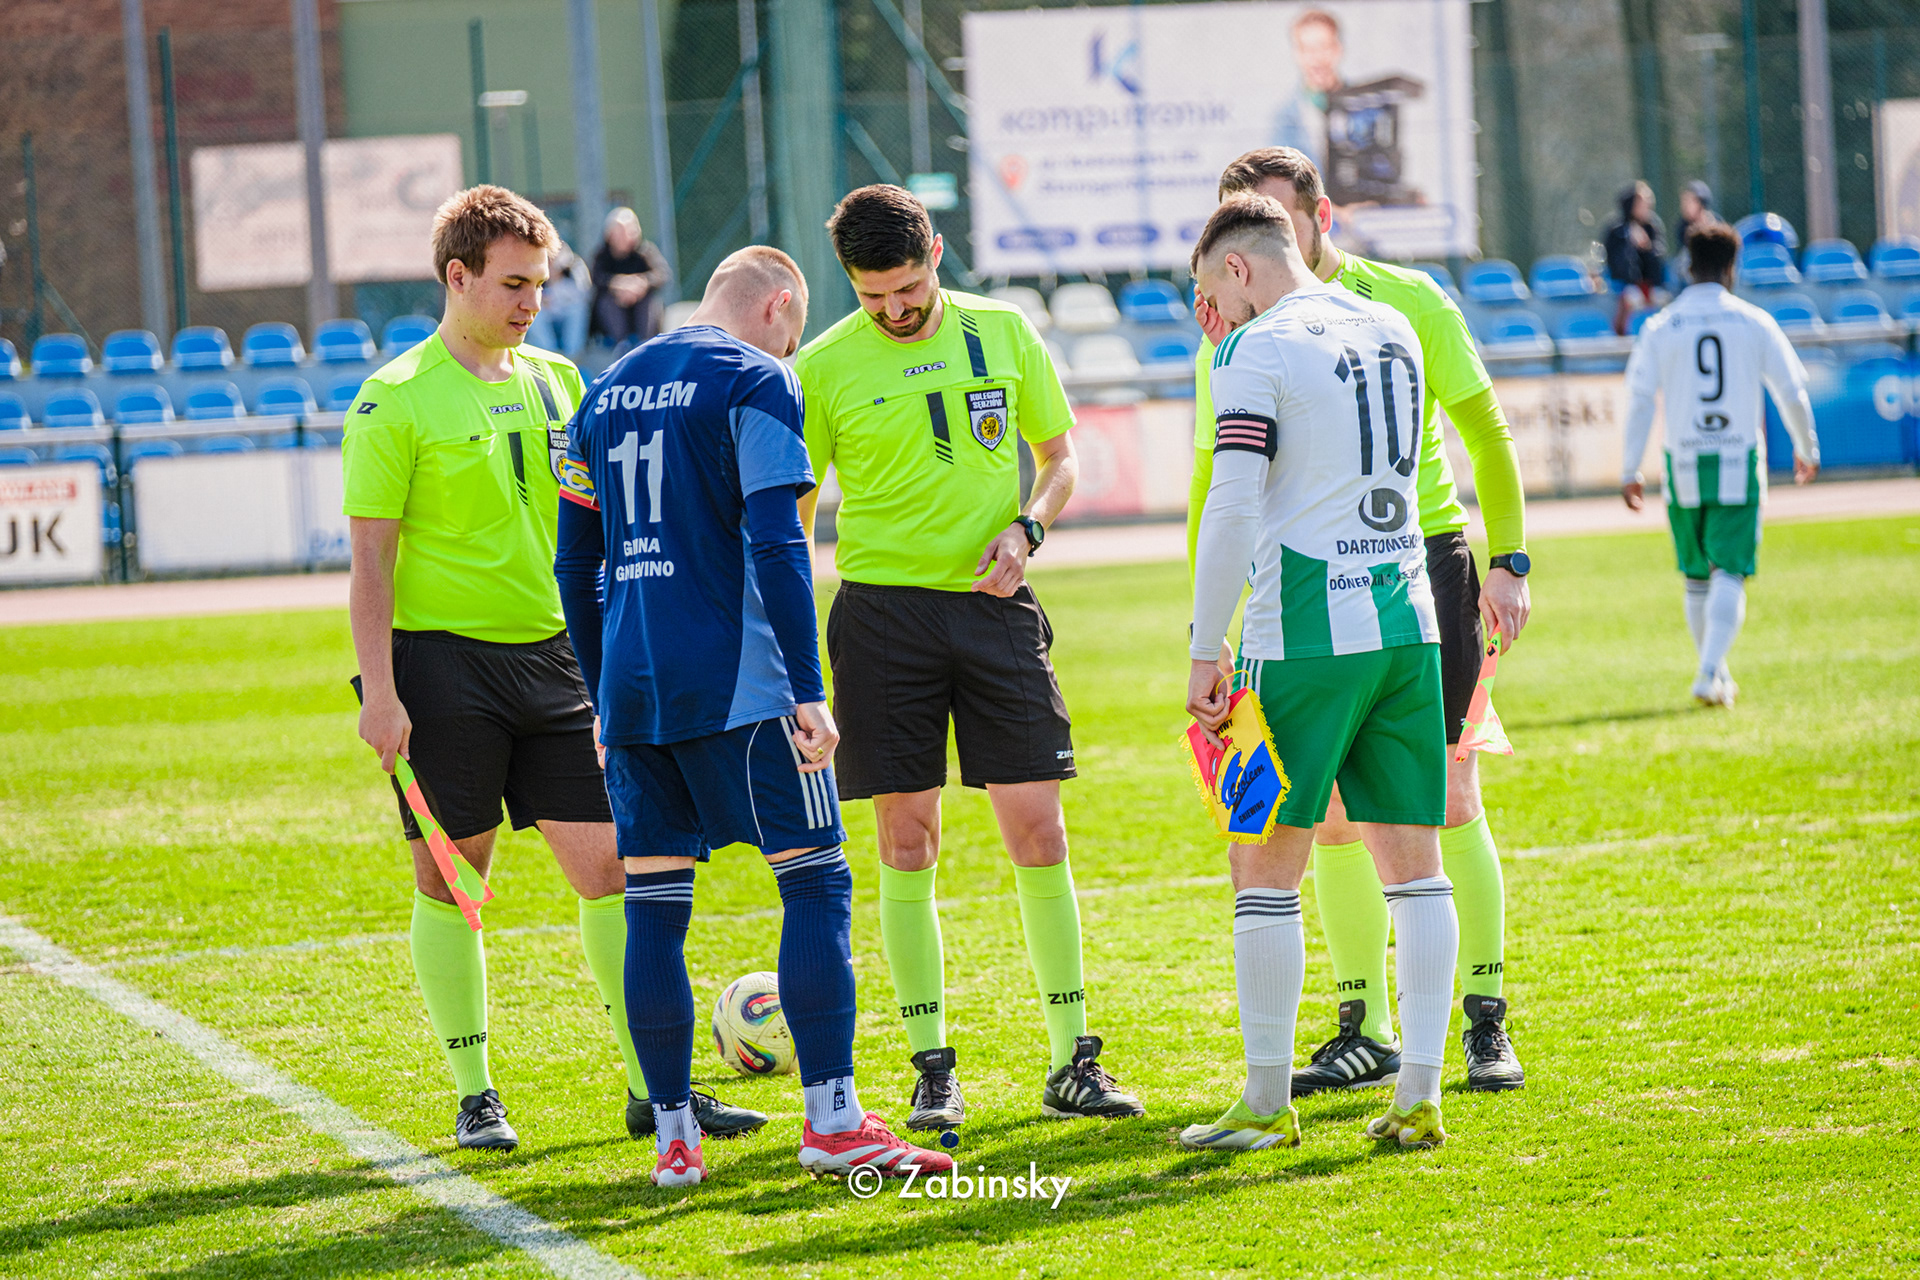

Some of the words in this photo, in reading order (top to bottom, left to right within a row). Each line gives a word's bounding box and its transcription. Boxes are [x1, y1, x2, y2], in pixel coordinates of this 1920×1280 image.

[595, 381, 698, 415] STOLEM
[1697, 334, 1724, 402] 9
[1334, 340, 1419, 477] 10
[608, 429, 664, 525] 11
[1238, 799, 1266, 825] GNIEWINO
